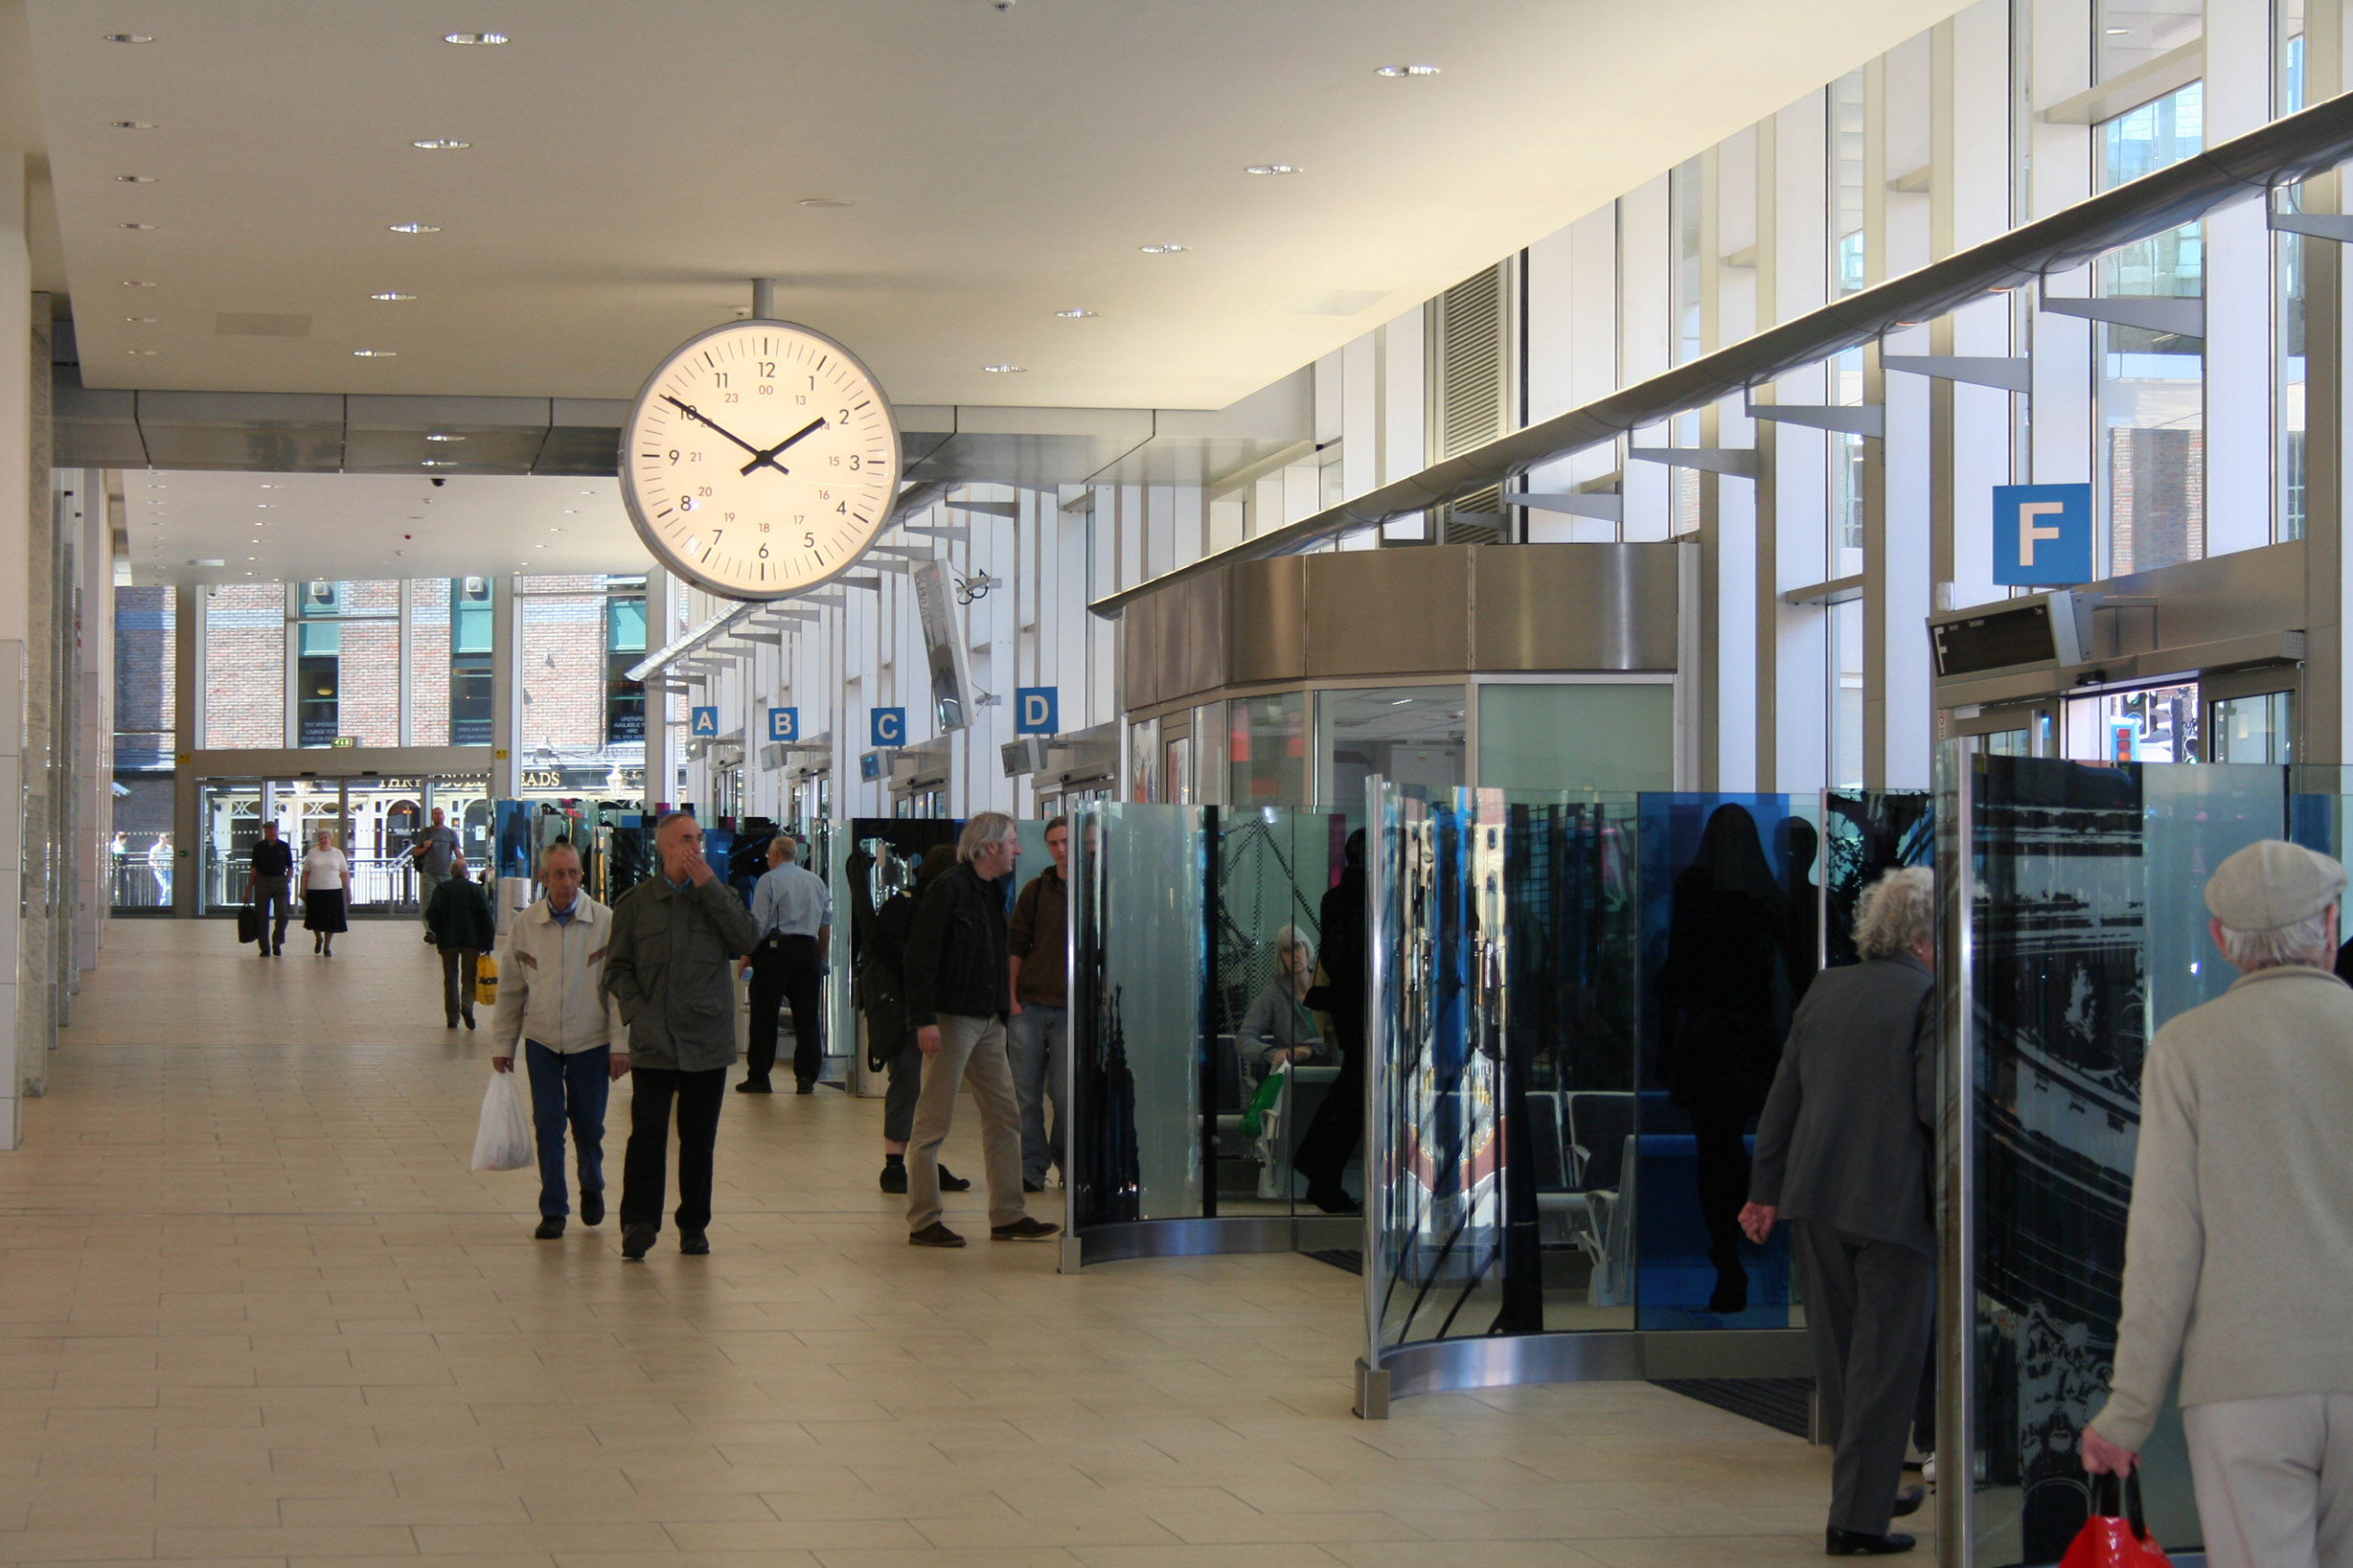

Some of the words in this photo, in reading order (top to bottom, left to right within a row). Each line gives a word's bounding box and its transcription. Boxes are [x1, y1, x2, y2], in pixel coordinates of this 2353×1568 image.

[758, 361, 776, 378] 12
[715, 373, 728, 388] 11
[808, 375, 814, 391] 1
[724, 393, 739, 403] 23
[758, 385, 773, 396] 00
[795, 395, 806, 405] 13
[839, 409, 850, 424] 2
[669, 449, 679, 466] 9
[690, 452, 702, 462] 21
[829, 456, 840, 466] 15
[850, 455, 860, 470] 3
[698, 487, 713, 497] 20
[819, 489, 830, 500] 16
[680, 495, 691, 511] 8
[835, 500, 847, 514] 4
[723, 512, 735, 522] 19
[793, 515, 805, 525] 17
[759, 523, 770, 533] 18
[2019, 502, 2064, 566] F
[712, 530, 723, 544] 7
[804, 532, 814, 548] 5
[758, 543, 768, 558] 6
[1933, 626, 1948, 674] F
[1025, 695, 1049, 726] D
[697, 712, 714, 731] A
[775, 713, 792, 736] B
[878, 714, 899, 739] C
